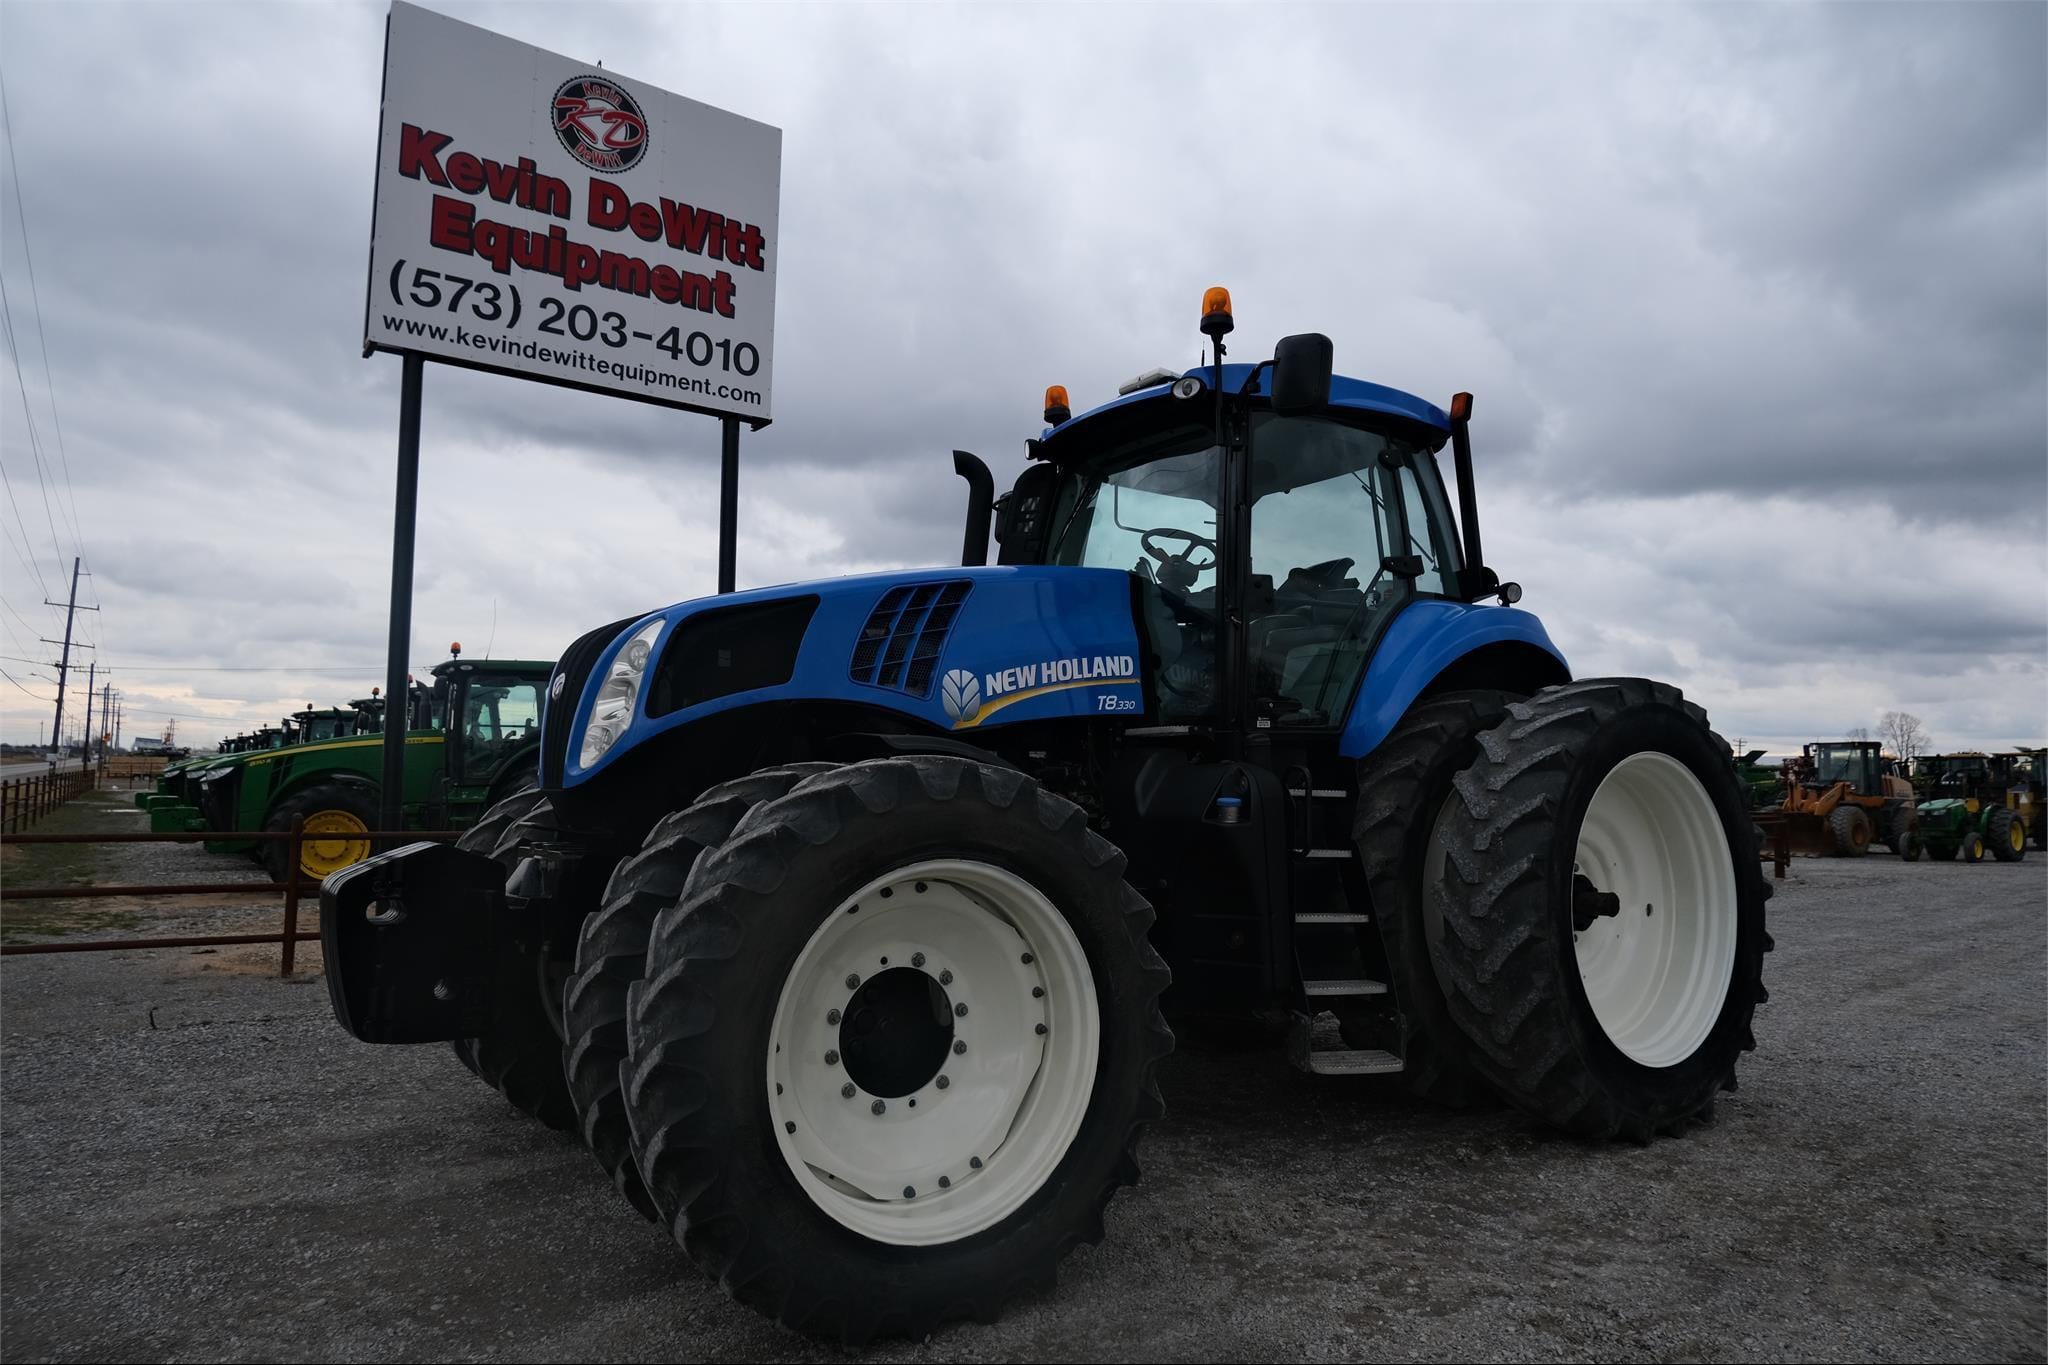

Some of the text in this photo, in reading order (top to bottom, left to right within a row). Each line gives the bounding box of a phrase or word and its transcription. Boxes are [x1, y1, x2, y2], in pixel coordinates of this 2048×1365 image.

[582, 80, 623, 106] Kevin
[399, 122, 765, 272] Kevin DeWitt
[575, 142, 624, 168] DeWitt
[430, 194, 736, 319] Equipment
[383, 315, 762, 405] www.kevindewittequipment.com
[389, 259, 760, 377] (573) 203-4010
[985, 664, 1037, 696] NEW
[1041, 656, 1134, 684] HOLLAND
